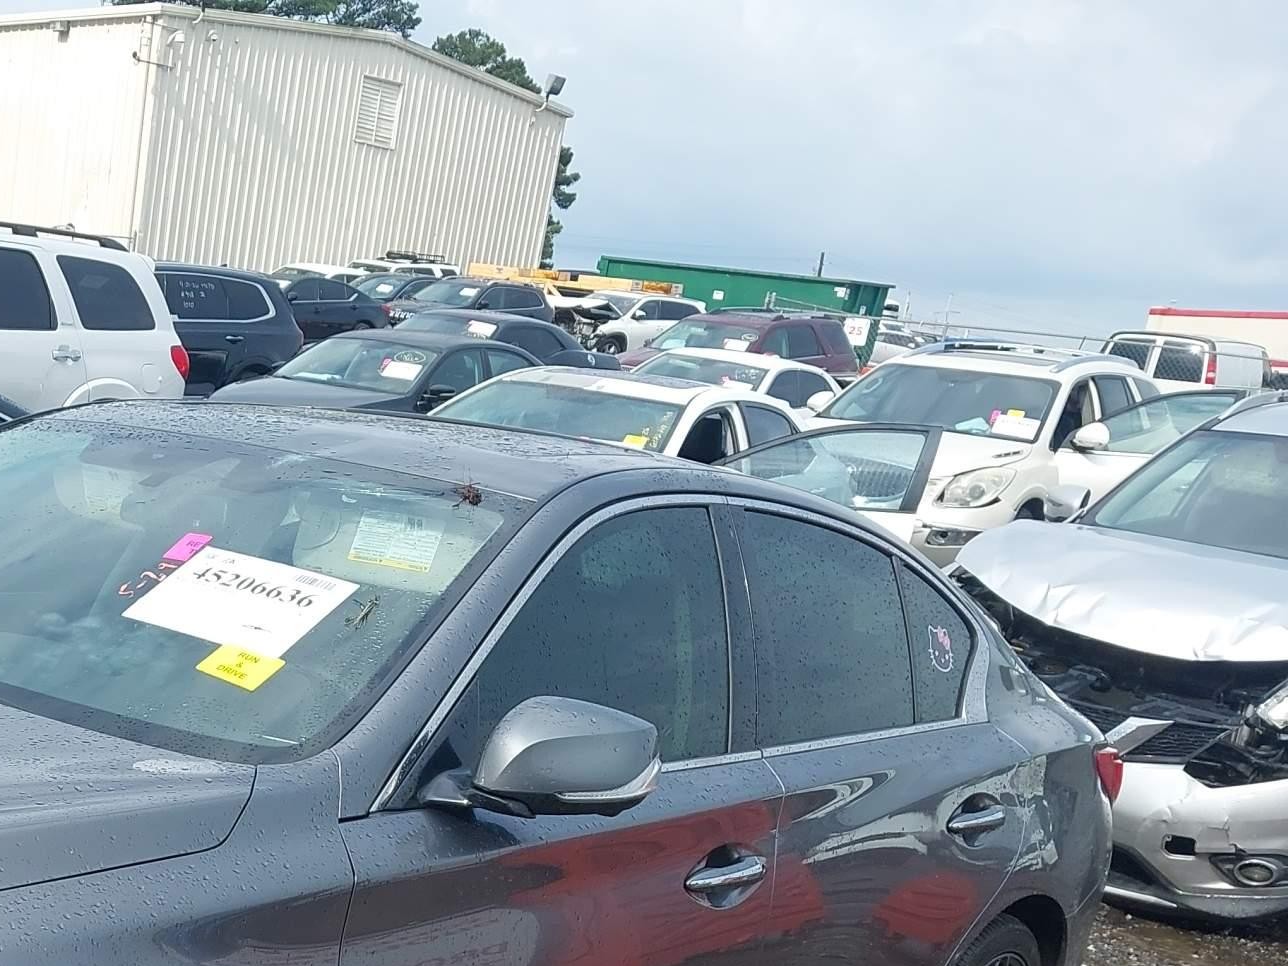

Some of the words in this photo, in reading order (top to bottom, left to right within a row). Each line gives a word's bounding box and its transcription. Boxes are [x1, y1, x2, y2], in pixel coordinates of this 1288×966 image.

[849, 326, 863, 336] 25
[193, 567, 318, 608] 45206636
[237, 651, 261, 664] RUN
[235, 661, 244, 669] &
[215, 664, 248, 680] DRIVE
